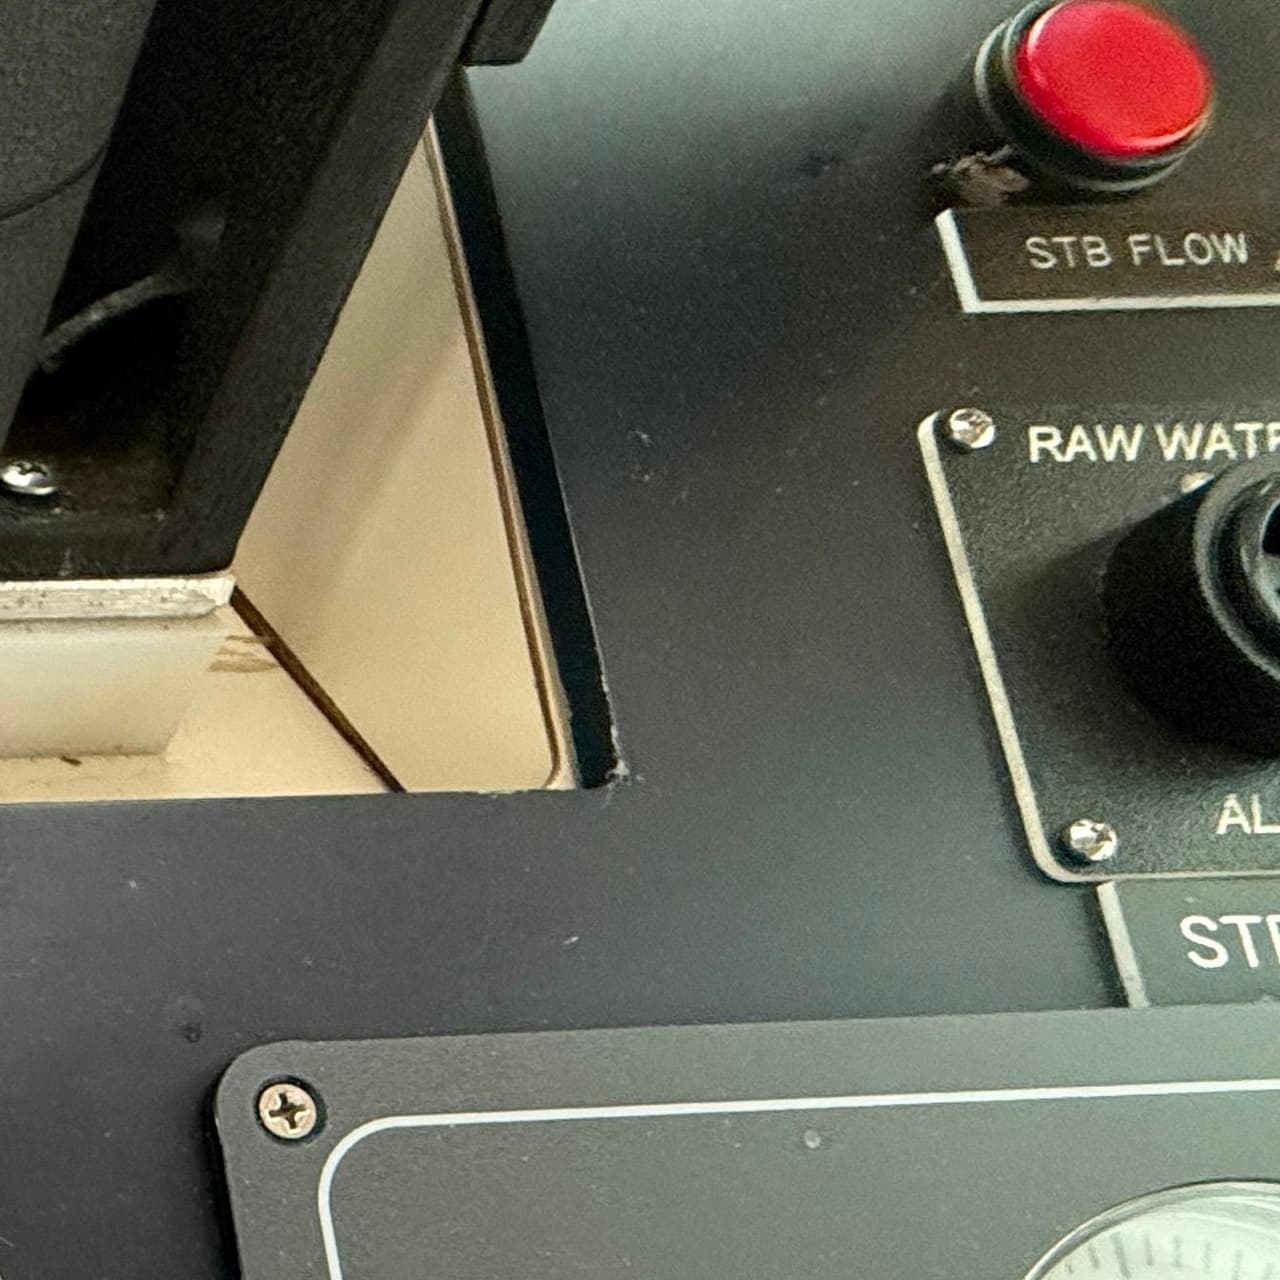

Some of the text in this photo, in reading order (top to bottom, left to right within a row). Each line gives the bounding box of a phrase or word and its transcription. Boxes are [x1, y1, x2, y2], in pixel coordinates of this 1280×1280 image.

[1025, 232, 1249, 270] STB FLOW
[1028, 423, 1144, 464] RAW
